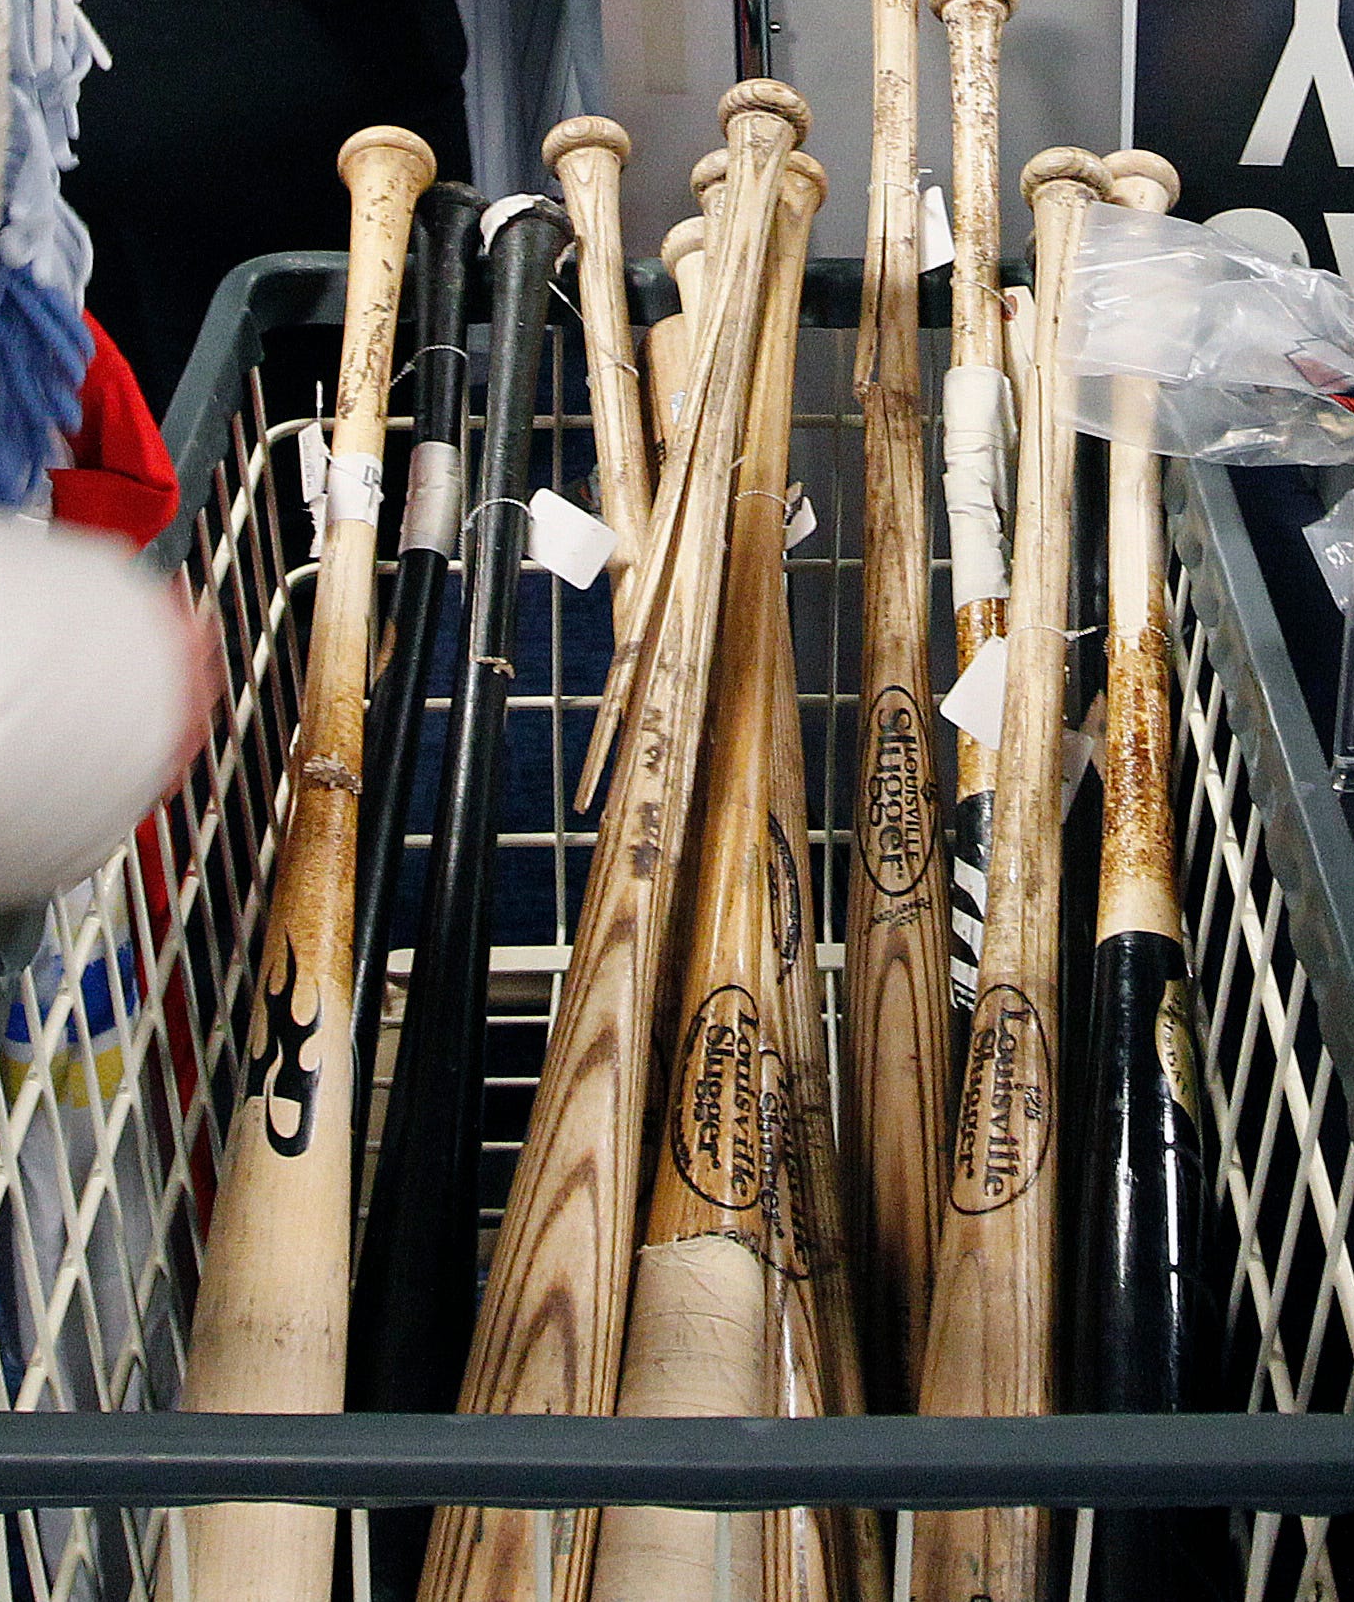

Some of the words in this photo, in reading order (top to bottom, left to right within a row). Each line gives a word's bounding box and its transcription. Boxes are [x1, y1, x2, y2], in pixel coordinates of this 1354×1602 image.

[867, 706, 919, 880] Slugger
[903, 744, 924, 862] LOUISVILLE
[694, 1024, 736, 1170] Slugger
[731, 1009, 760, 1197] Louisville
[959, 1028, 996, 1179] Slugger
[985, 1008, 1033, 1196] Louisville
